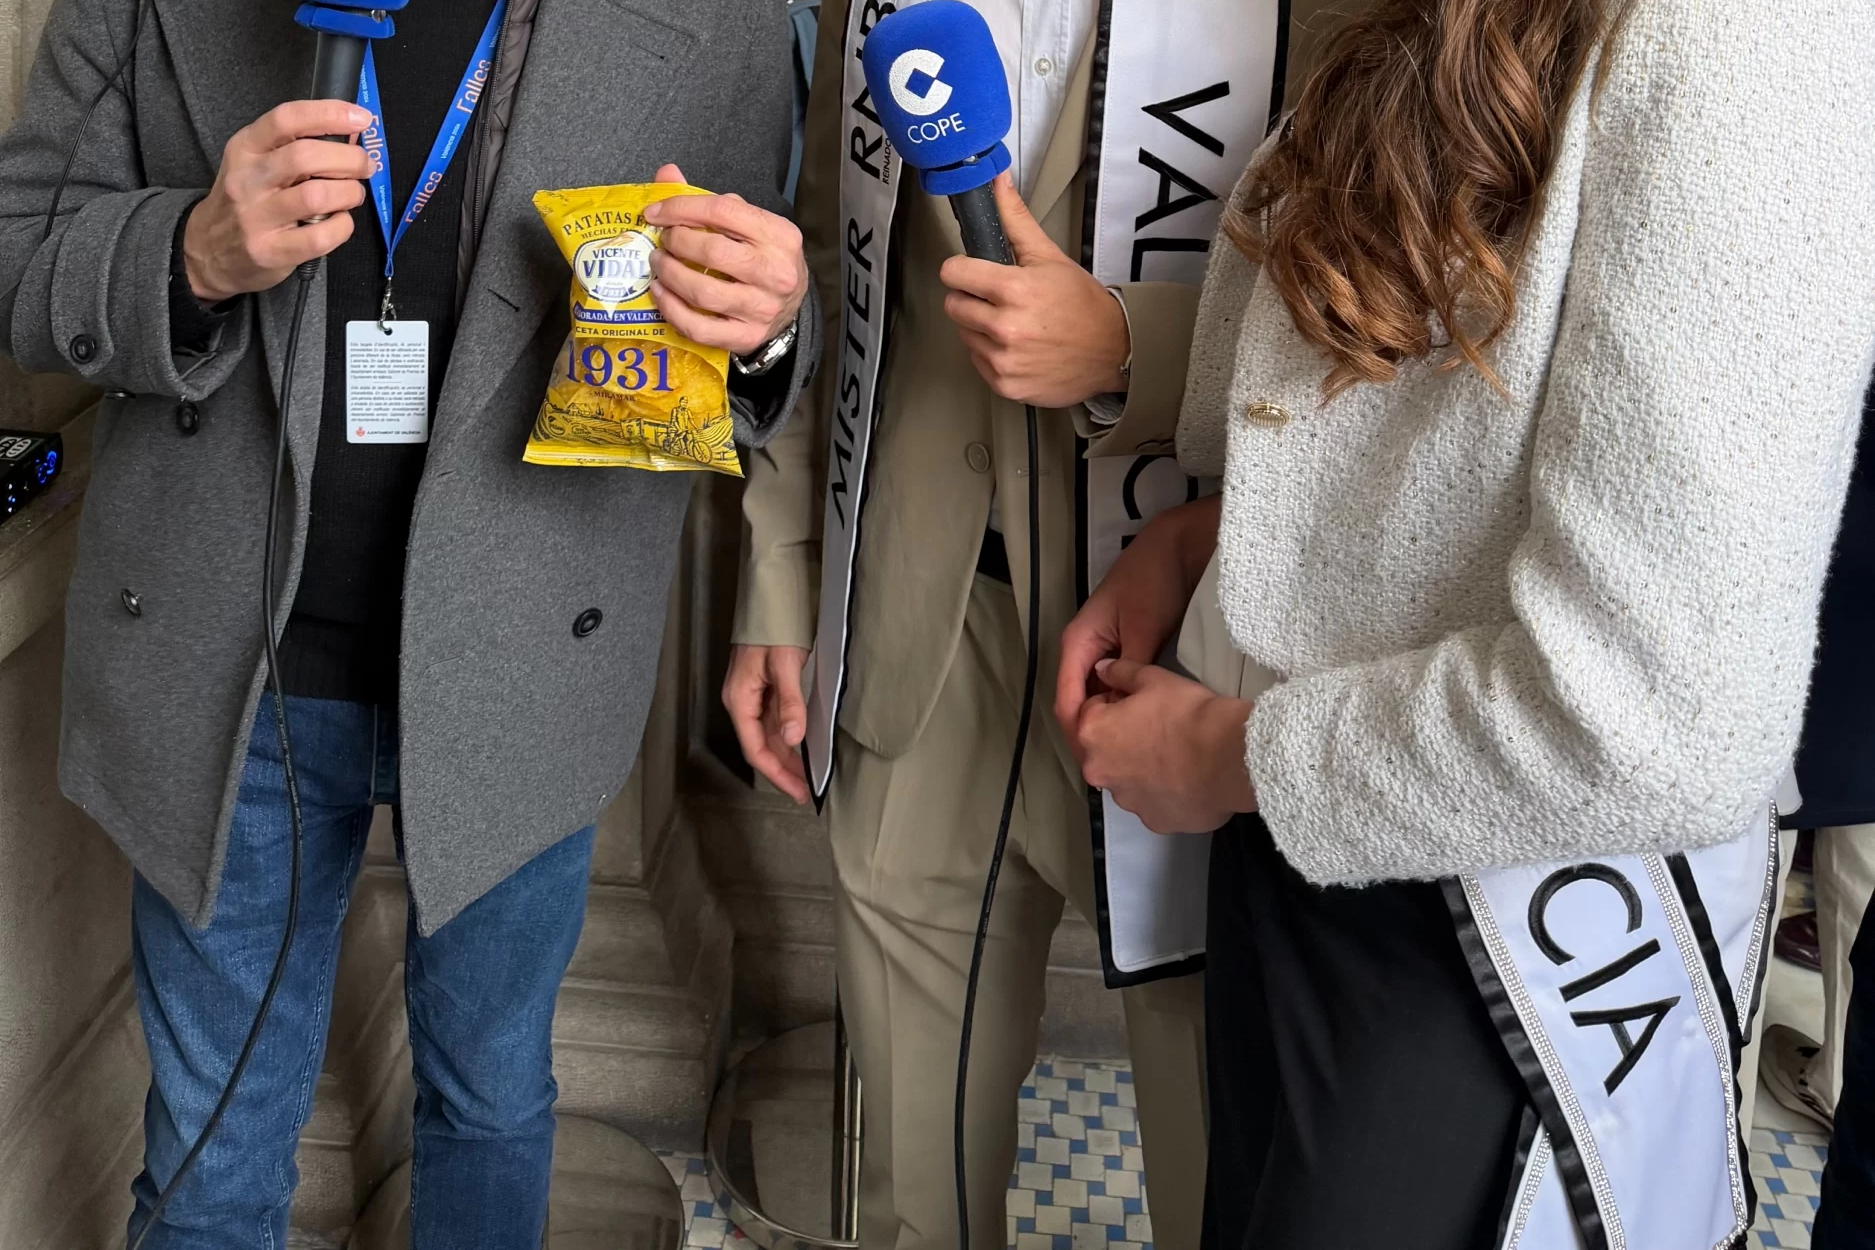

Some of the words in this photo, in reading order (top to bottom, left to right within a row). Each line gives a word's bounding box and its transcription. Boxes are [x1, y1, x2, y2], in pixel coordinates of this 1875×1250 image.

[907, 112, 967, 144] COPE
[882, 137, 892, 185] REINADO
[562, 211, 631, 236] PATATAS
[592, 248, 642, 260] VICENTE
[582, 260, 650, 280] VIDAL
[614, 312, 626, 322] EN
[626, 311, 664, 322] VALENCI
[602, 328, 649, 337] ORIGINAL
[652, 328, 666, 336] DE
[566, 340, 675, 392] 1931
[831, 217, 874, 530] MISTER
[594, 391, 636, 402] MIRAMAR
